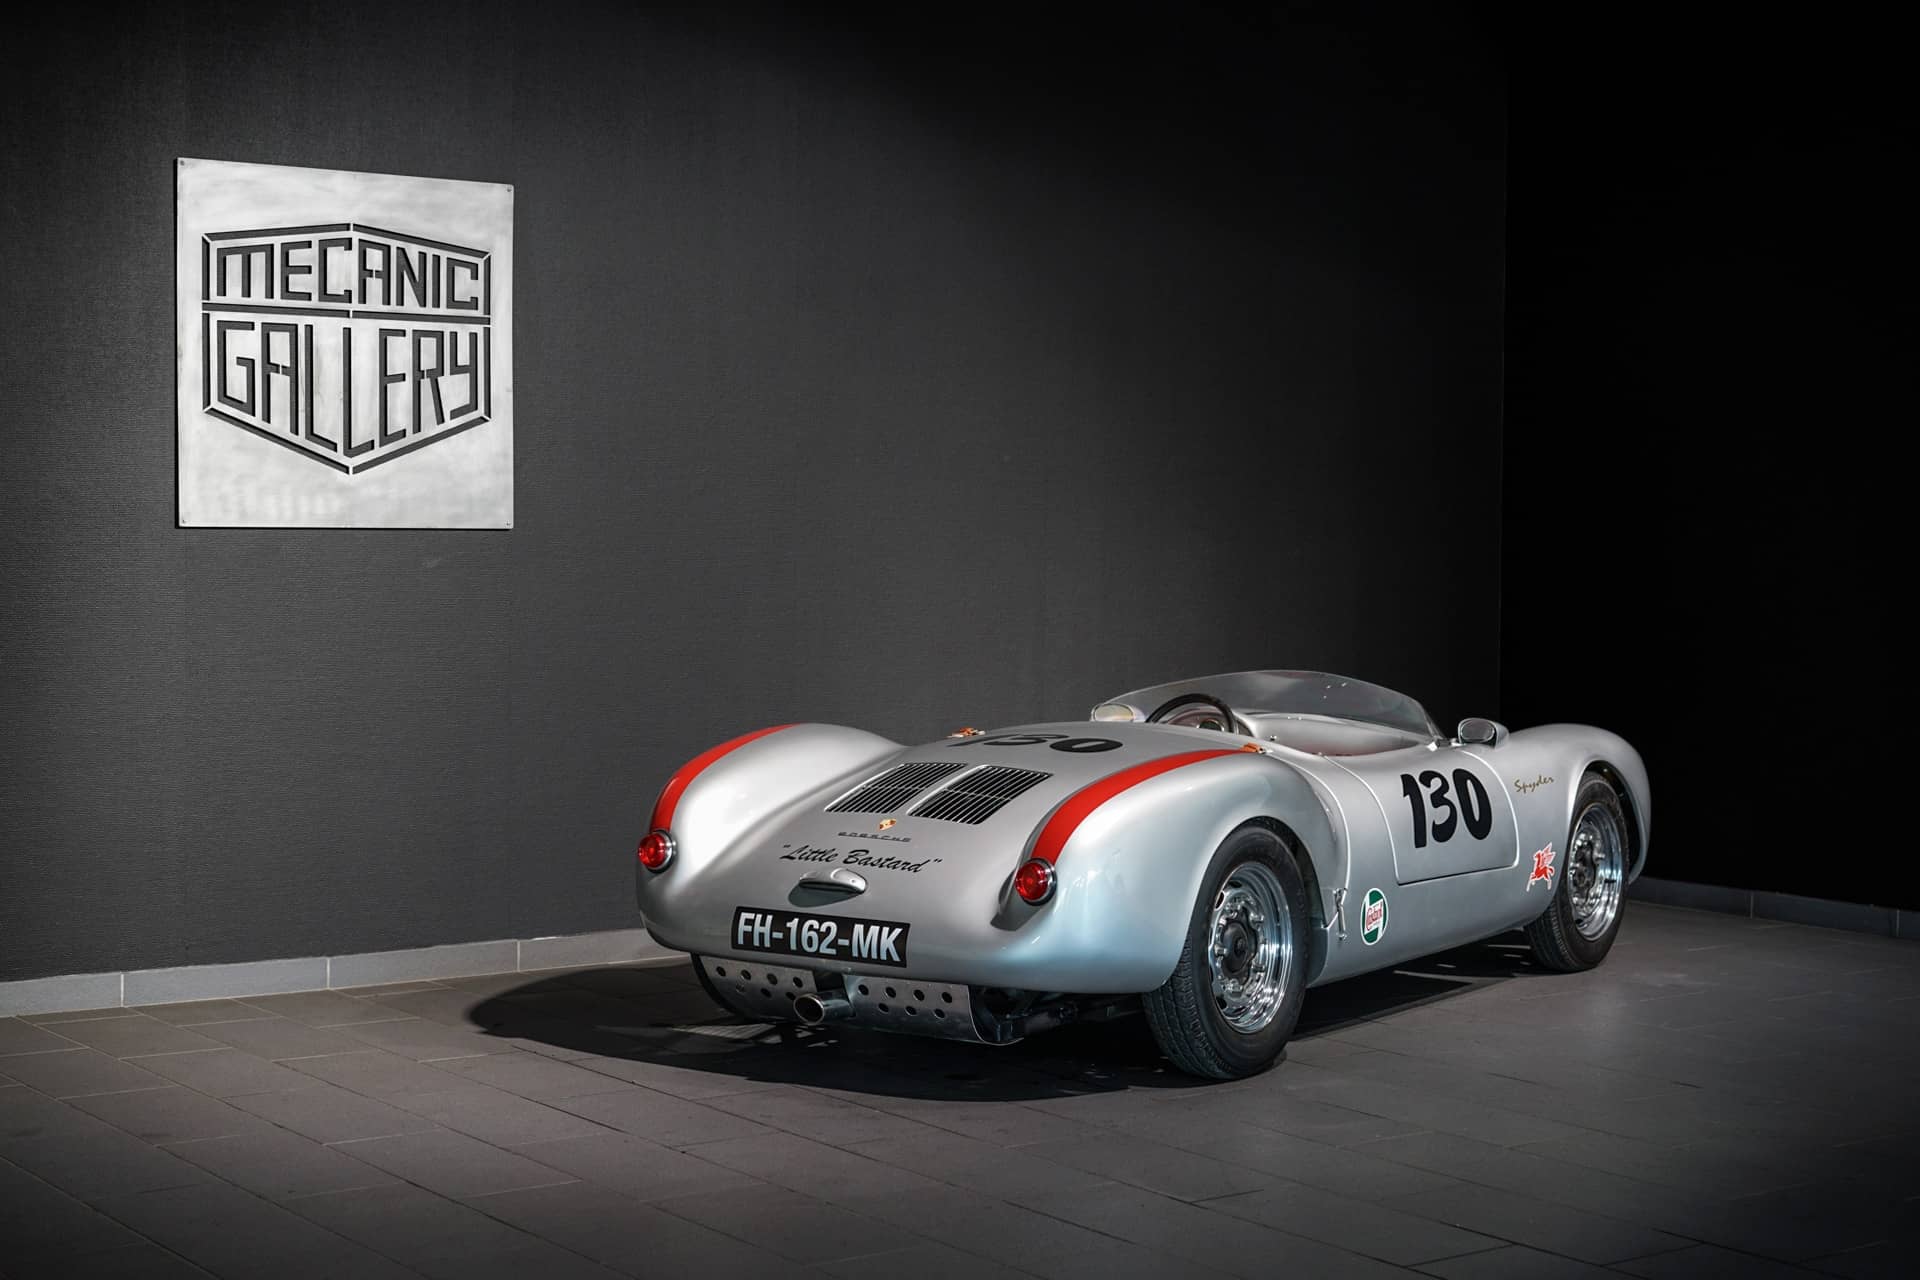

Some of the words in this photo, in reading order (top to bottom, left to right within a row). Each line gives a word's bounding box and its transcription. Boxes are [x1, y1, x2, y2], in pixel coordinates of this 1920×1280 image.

[217, 237, 479, 311] MECANIC
[217, 319, 479, 459] GALLERY
[1400, 768, 1493, 849] 130
[1514, 774, 1555, 794] Spyder
[837, 831, 912, 843] PORSCHE
[736, 911, 905, 962] FH-162-MK
